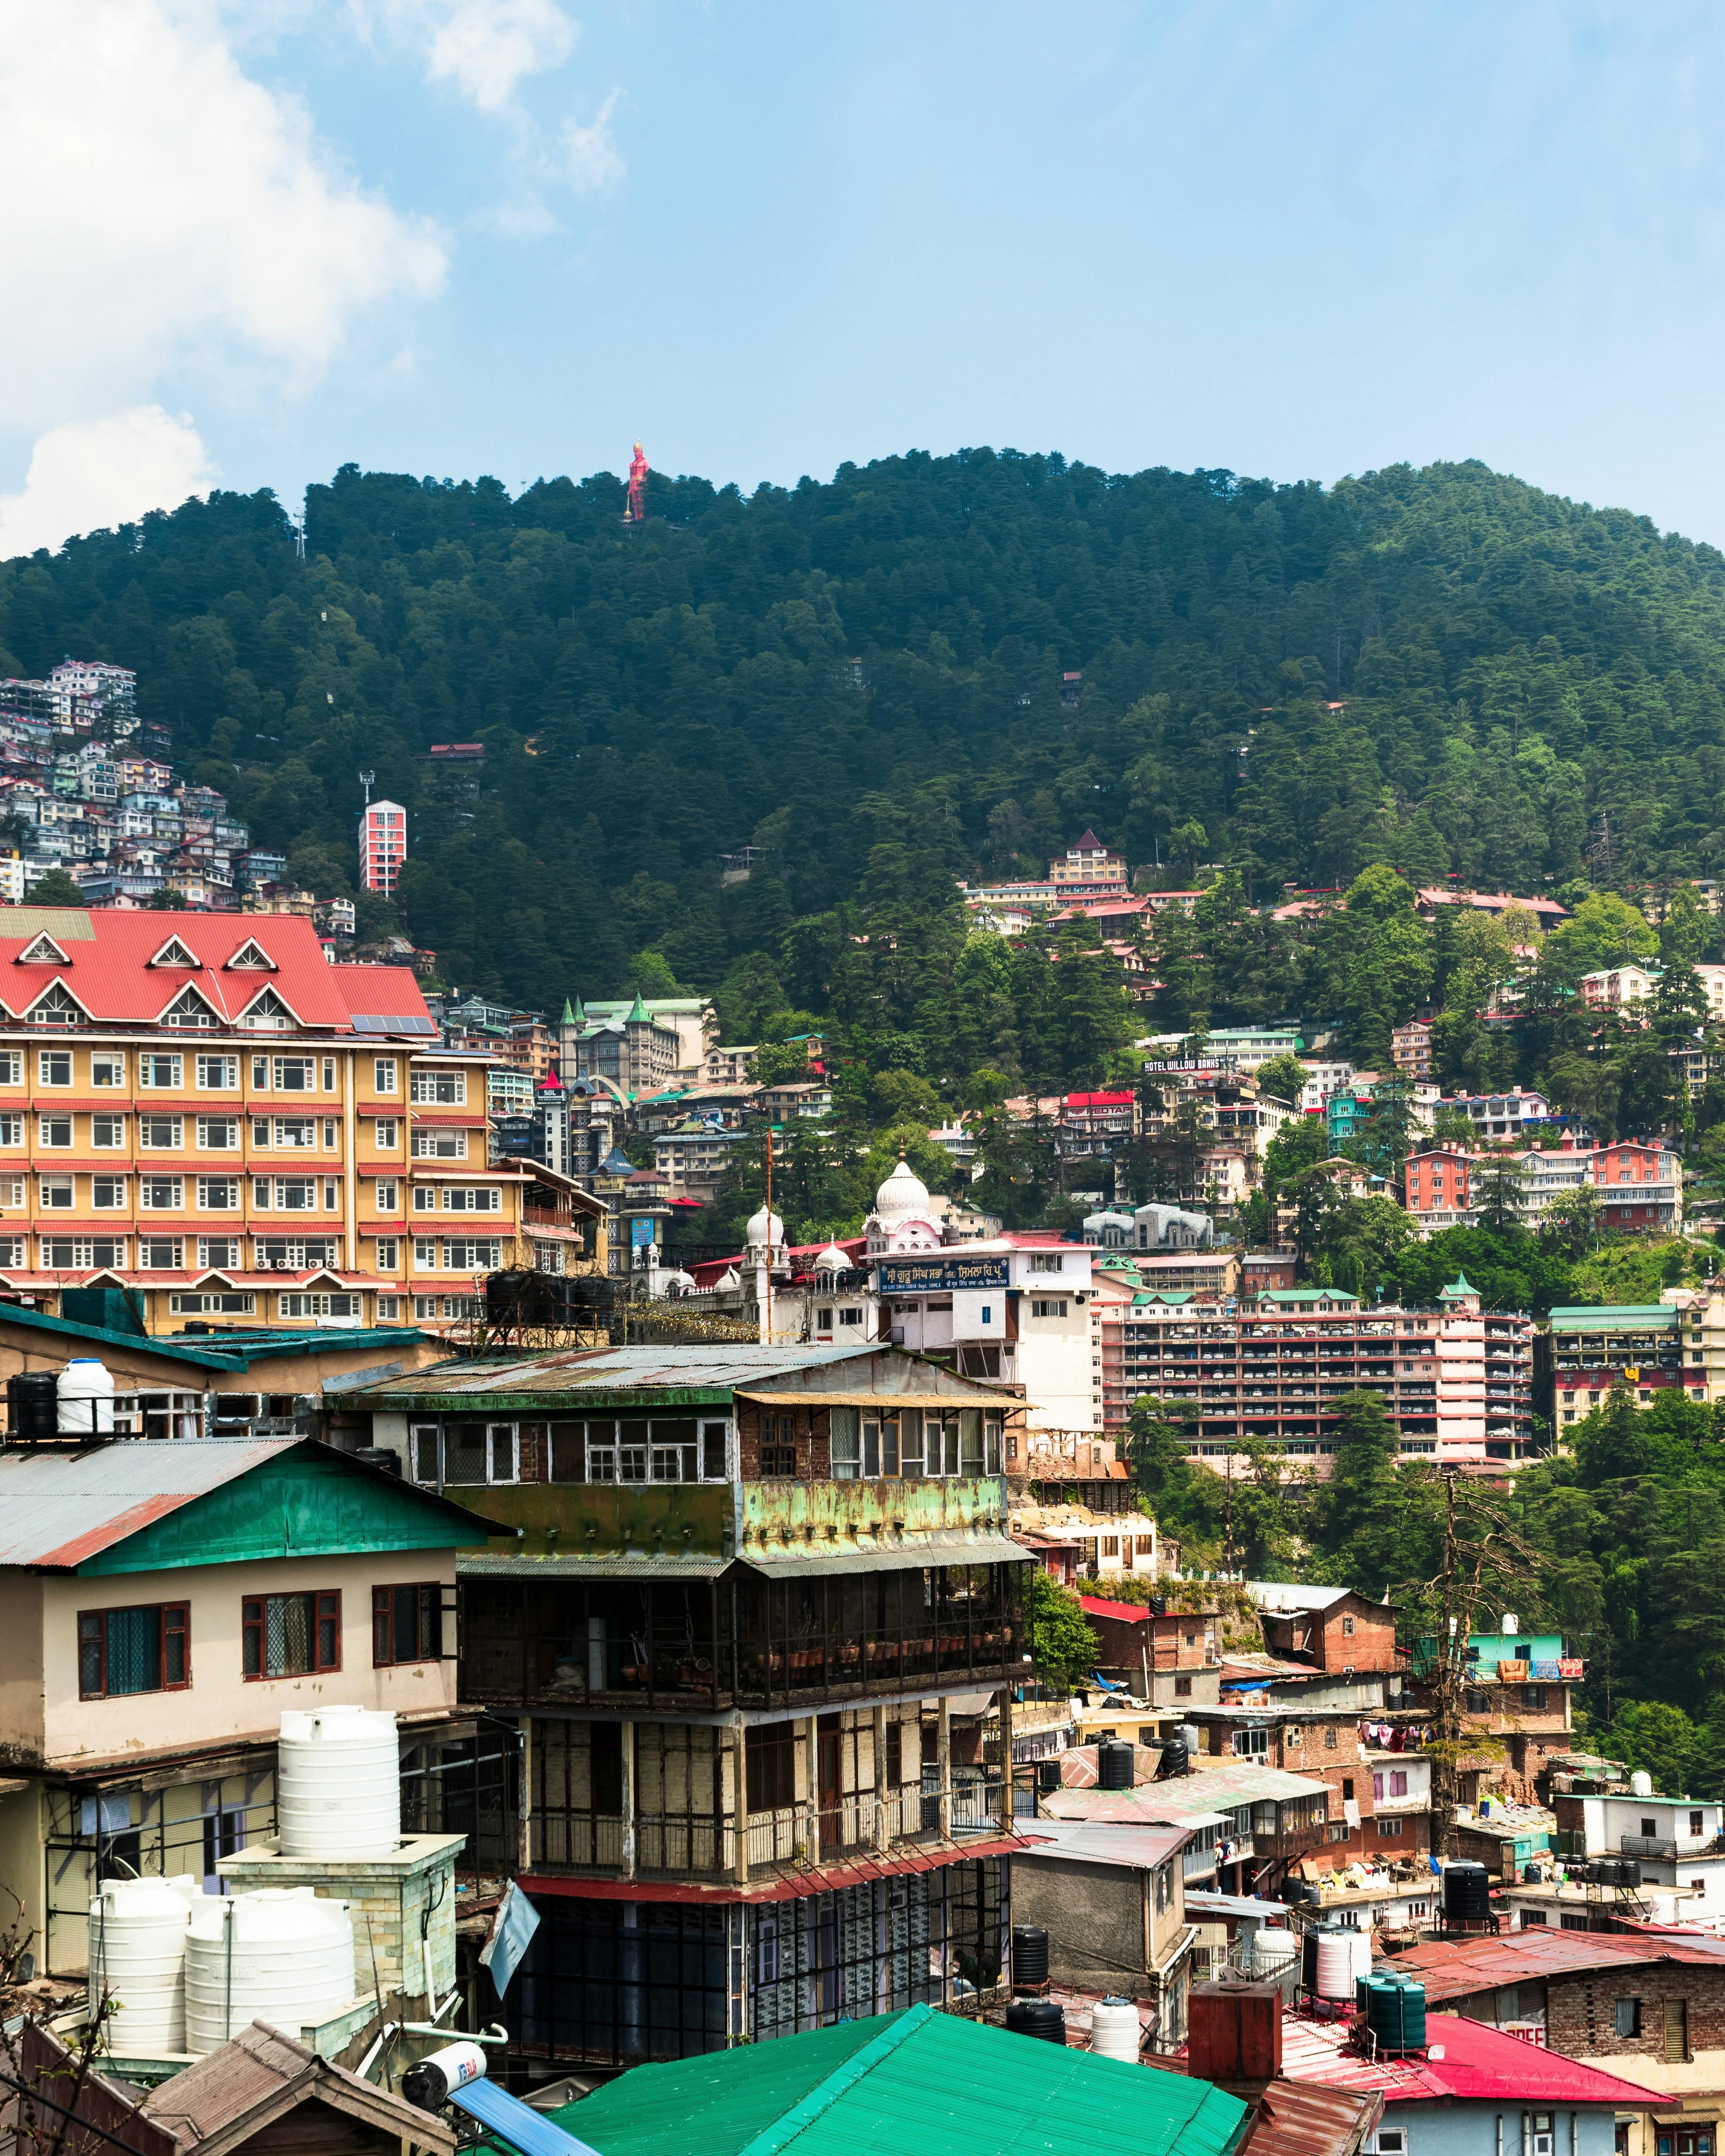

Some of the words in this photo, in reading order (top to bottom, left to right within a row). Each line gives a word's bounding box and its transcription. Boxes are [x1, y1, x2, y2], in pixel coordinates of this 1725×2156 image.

[1145, 1061, 1166, 1072] HOTEL
[1167, 1060, 1195, 1071] WILLOW
[1198, 1058, 1219, 1069] BANKS
